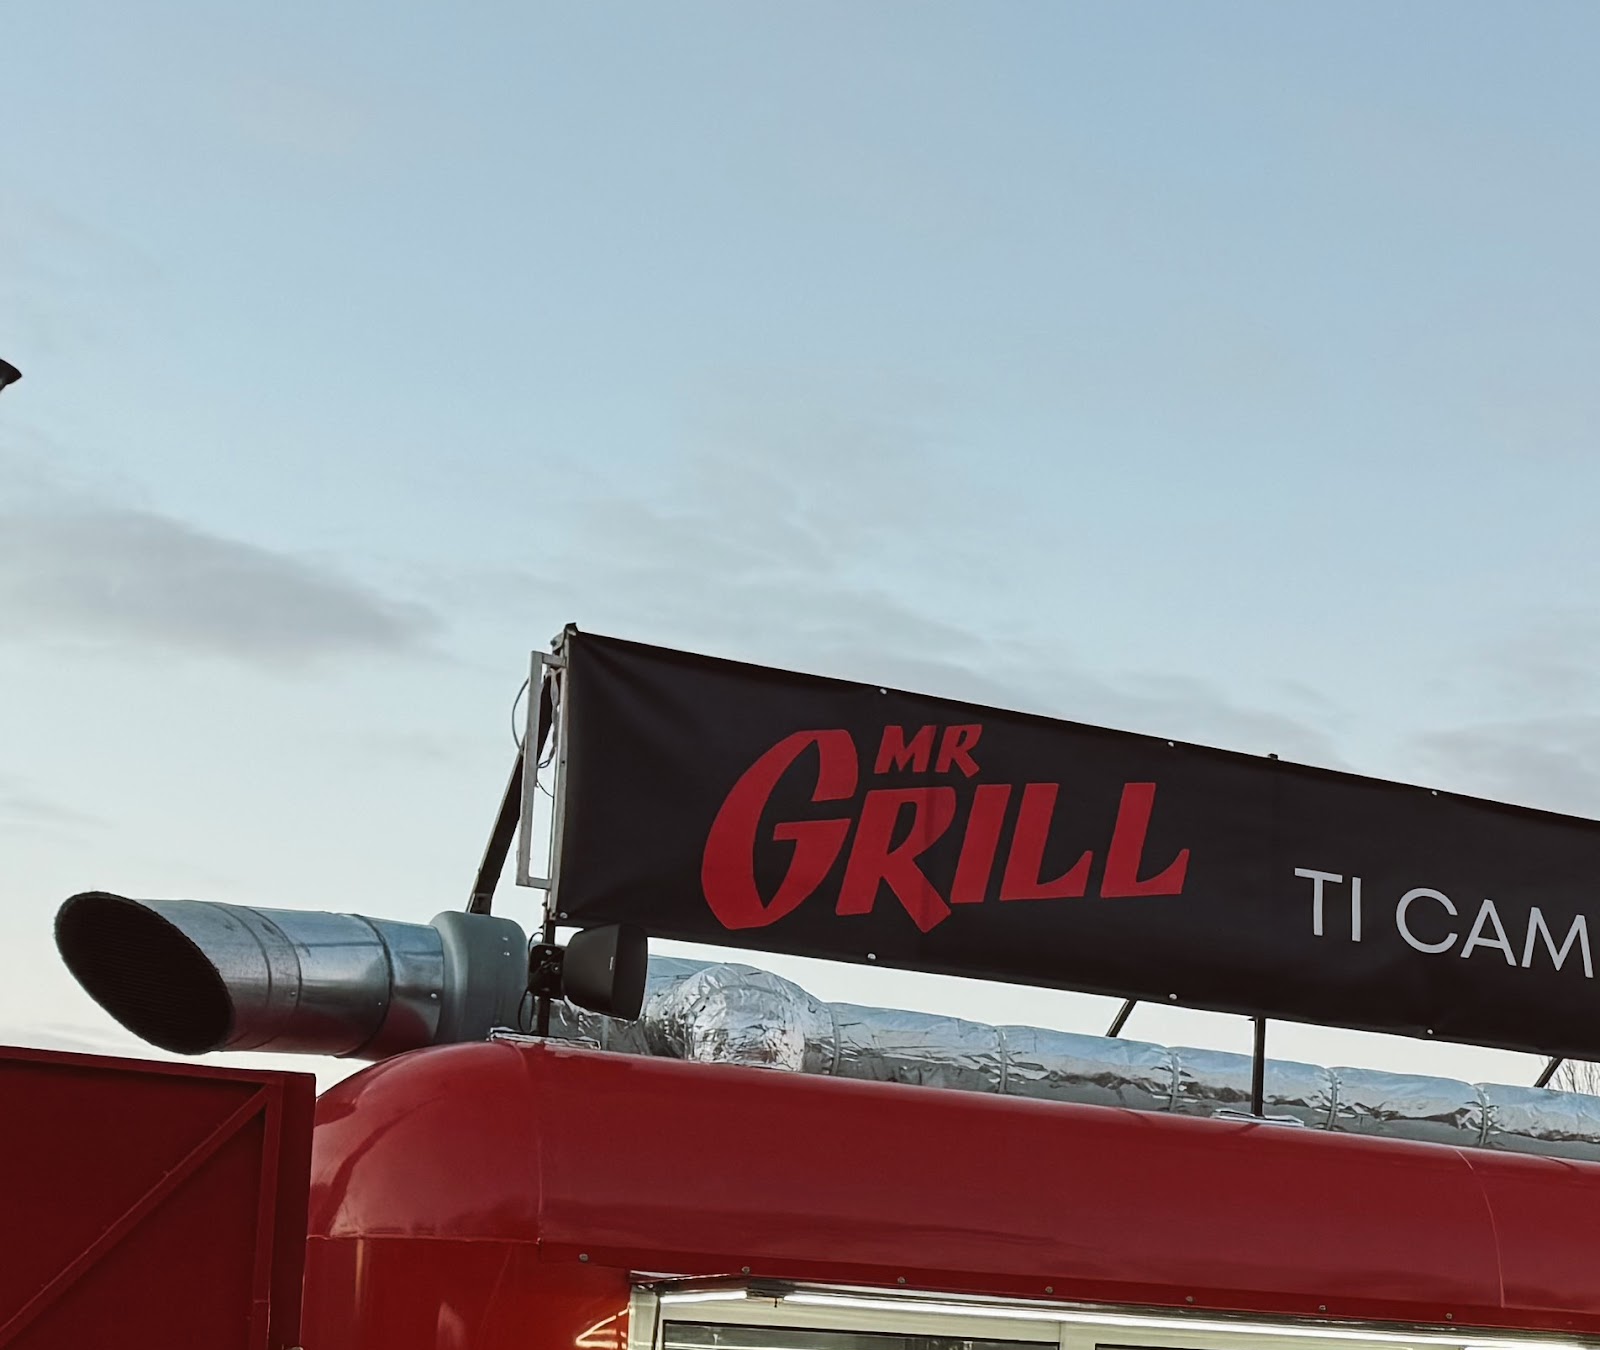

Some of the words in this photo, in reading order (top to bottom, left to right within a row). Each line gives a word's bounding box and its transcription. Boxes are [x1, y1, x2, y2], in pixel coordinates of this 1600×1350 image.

[873, 724, 982, 778] MR
[700, 728, 1190, 933] GRILL
[1294, 868, 1361, 942] ТІ
